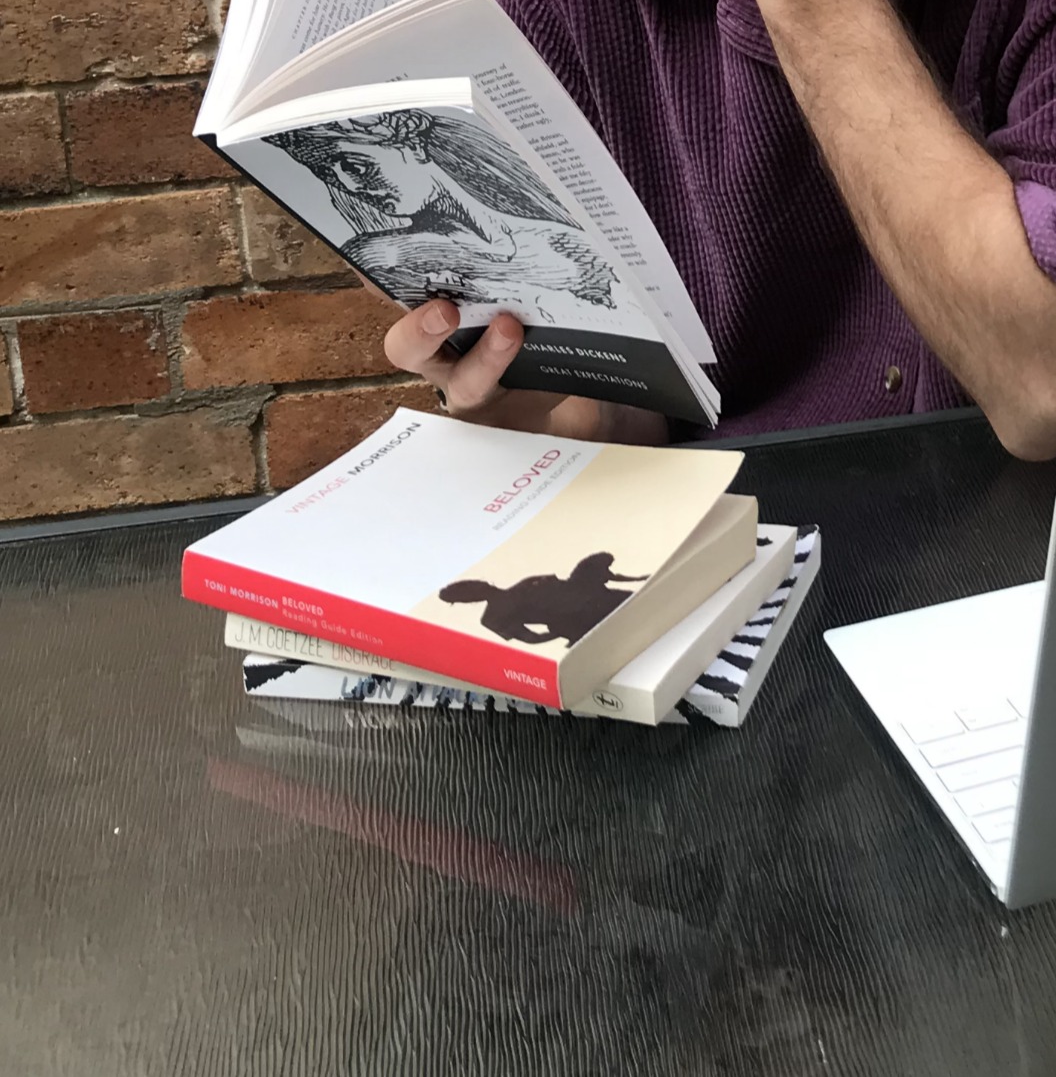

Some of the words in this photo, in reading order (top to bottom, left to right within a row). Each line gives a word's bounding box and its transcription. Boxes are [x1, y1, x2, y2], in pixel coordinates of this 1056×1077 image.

[524, 342, 574, 355] CHARLES
[576, 347, 627, 363] DICKENS
[540, 365, 572, 377] GREAT
[574, 369, 648, 391] EXPECTATIONS
[286, 476, 349, 514] VINTAGE
[347, 422, 422, 476] MORRISON
[483, 449, 561, 513] BELOVED
[204, 578, 226, 594] TONI
[229, 586, 279, 609] MORRISON
[281, 595, 324, 617] BELOVED
[282, 608, 318, 629] Reading
[321, 619, 347, 636] Guide
[350, 627, 384, 646] Edition
[266, 626, 324, 658] COETZEE
[340, 674, 397, 700] LION
[503, 668, 548, 690] VINTAGE
